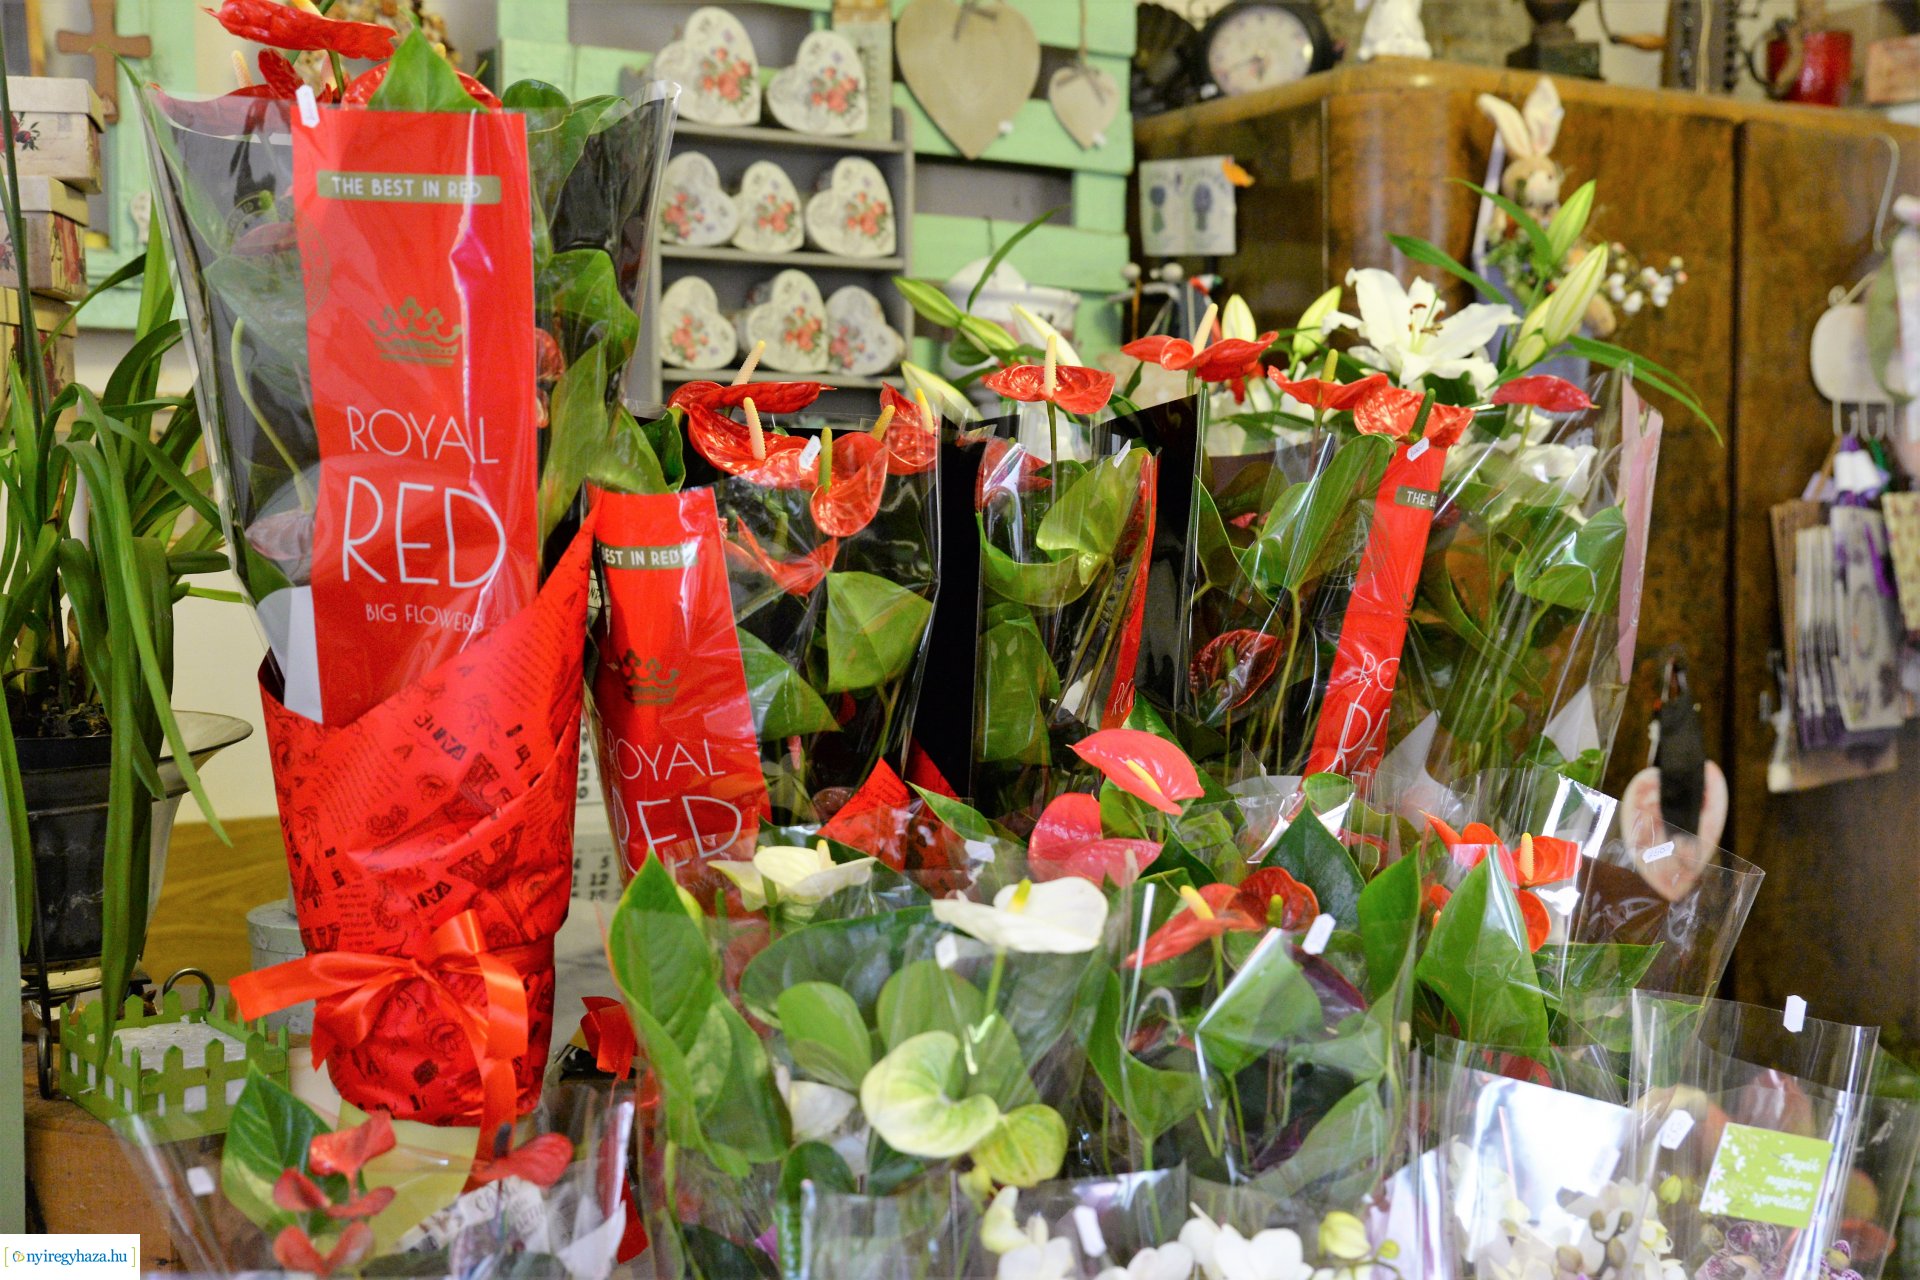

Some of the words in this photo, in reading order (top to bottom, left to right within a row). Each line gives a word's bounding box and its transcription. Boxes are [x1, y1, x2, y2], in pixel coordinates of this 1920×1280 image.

[332, 176, 363, 195] THE
[371, 178, 414, 197] BEST
[422, 180, 440, 197] IN
[447, 182, 482, 198] RED
[346, 405, 499, 464] ROYAL
[1407, 490, 1427, 505] THE
[342, 475, 507, 588] RED
[630, 549, 646, 566] IN
[365, 603, 397, 622] BIG
[405, 604, 484, 632] FLOWERS
[607, 728, 726, 782] ROYAL
